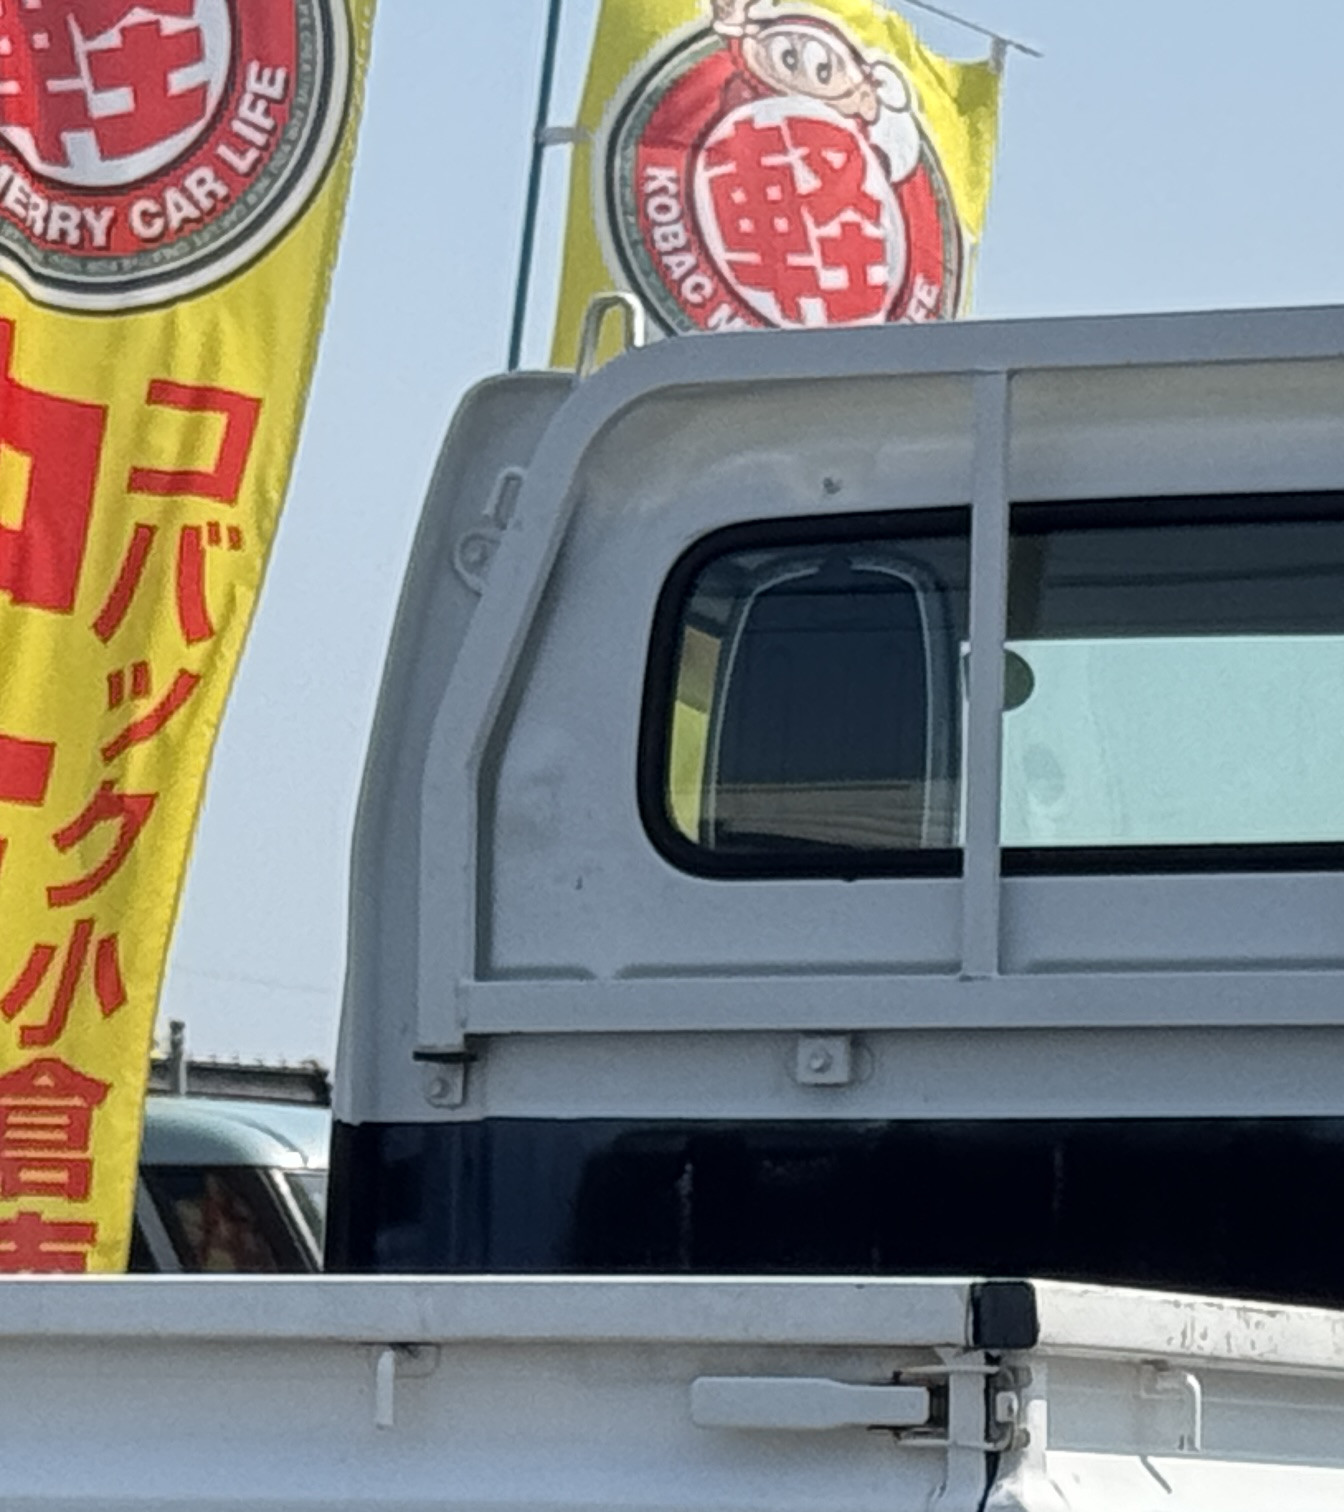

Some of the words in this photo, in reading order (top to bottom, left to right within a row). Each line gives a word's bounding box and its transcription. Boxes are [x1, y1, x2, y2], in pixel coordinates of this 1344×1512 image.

[129, 165, 230, 240] CAR
[216, 60, 287, 174] LIFE
[643, 166, 714, 304] KOBAC
